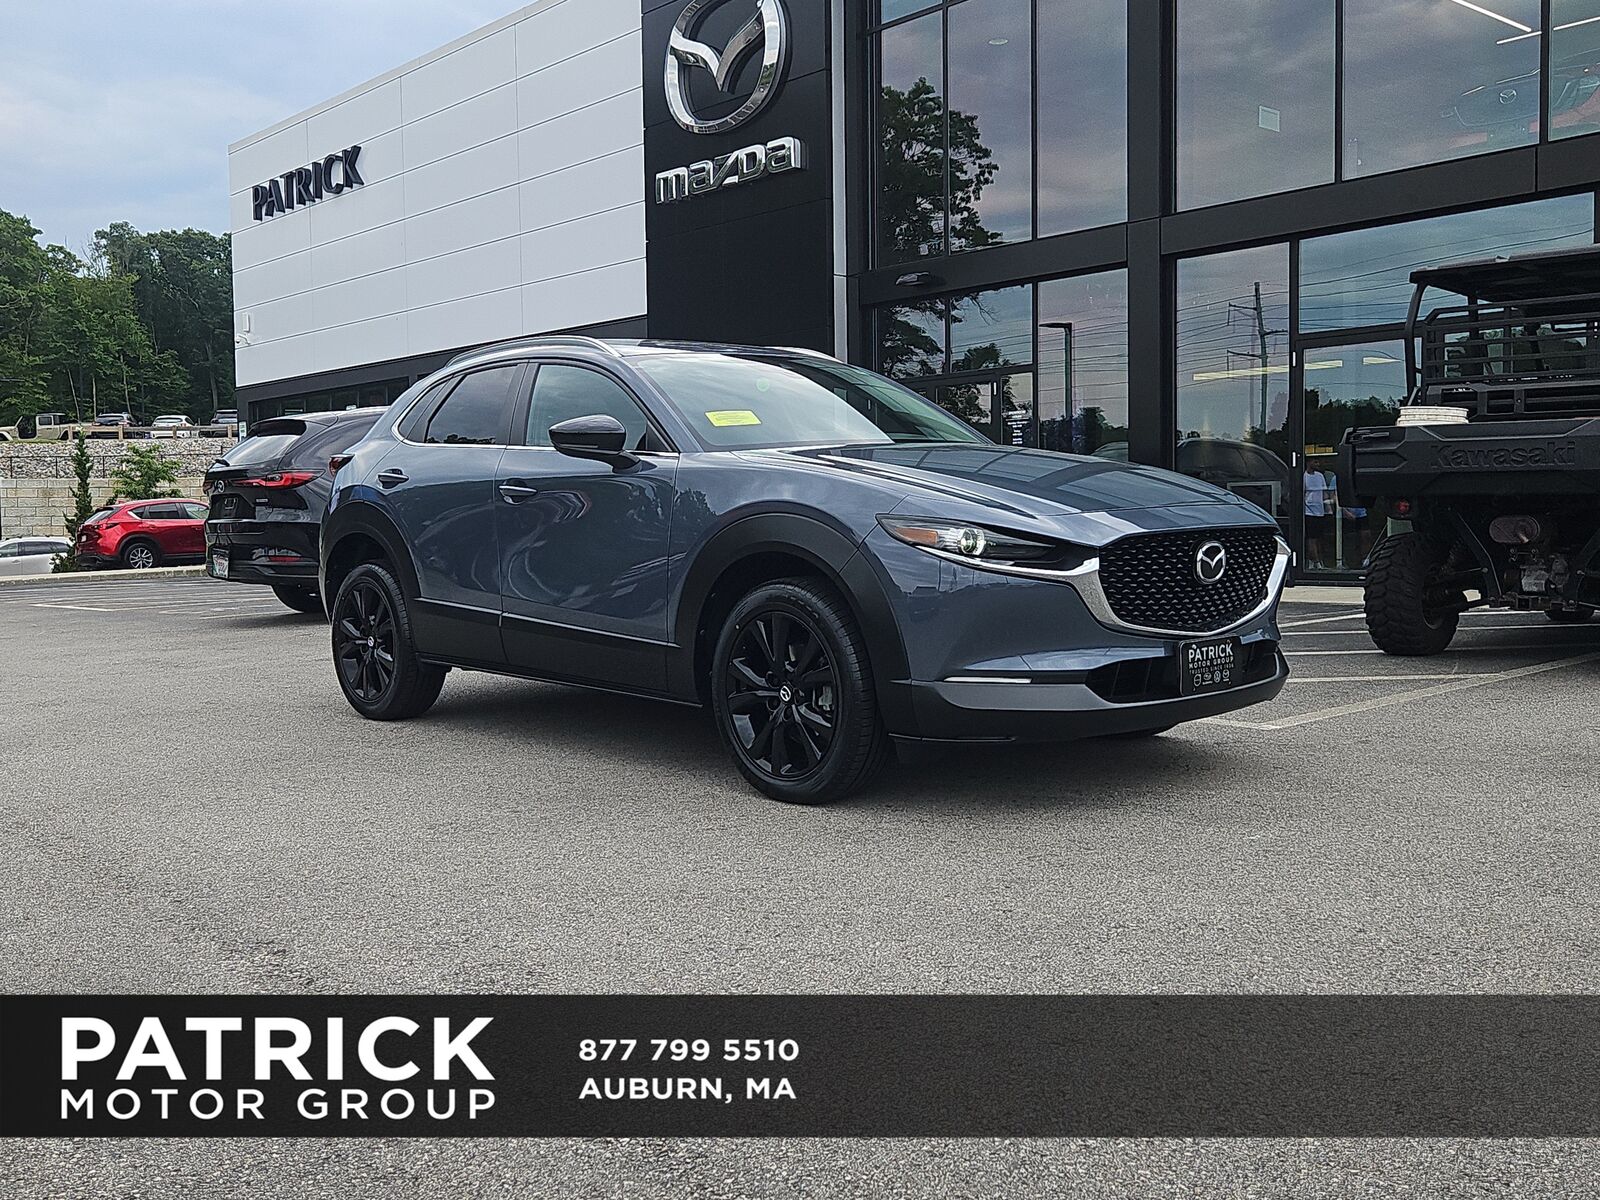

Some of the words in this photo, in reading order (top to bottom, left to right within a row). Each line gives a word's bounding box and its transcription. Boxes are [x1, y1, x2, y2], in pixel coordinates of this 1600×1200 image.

[252, 145, 364, 222] PATRICK
[1429, 440, 1576, 468] Kawasaki
[1188, 642, 1234, 663] PATRICK
[1188, 660, 1211, 669] MOTOR
[1213, 656, 1234, 665] GROUP
